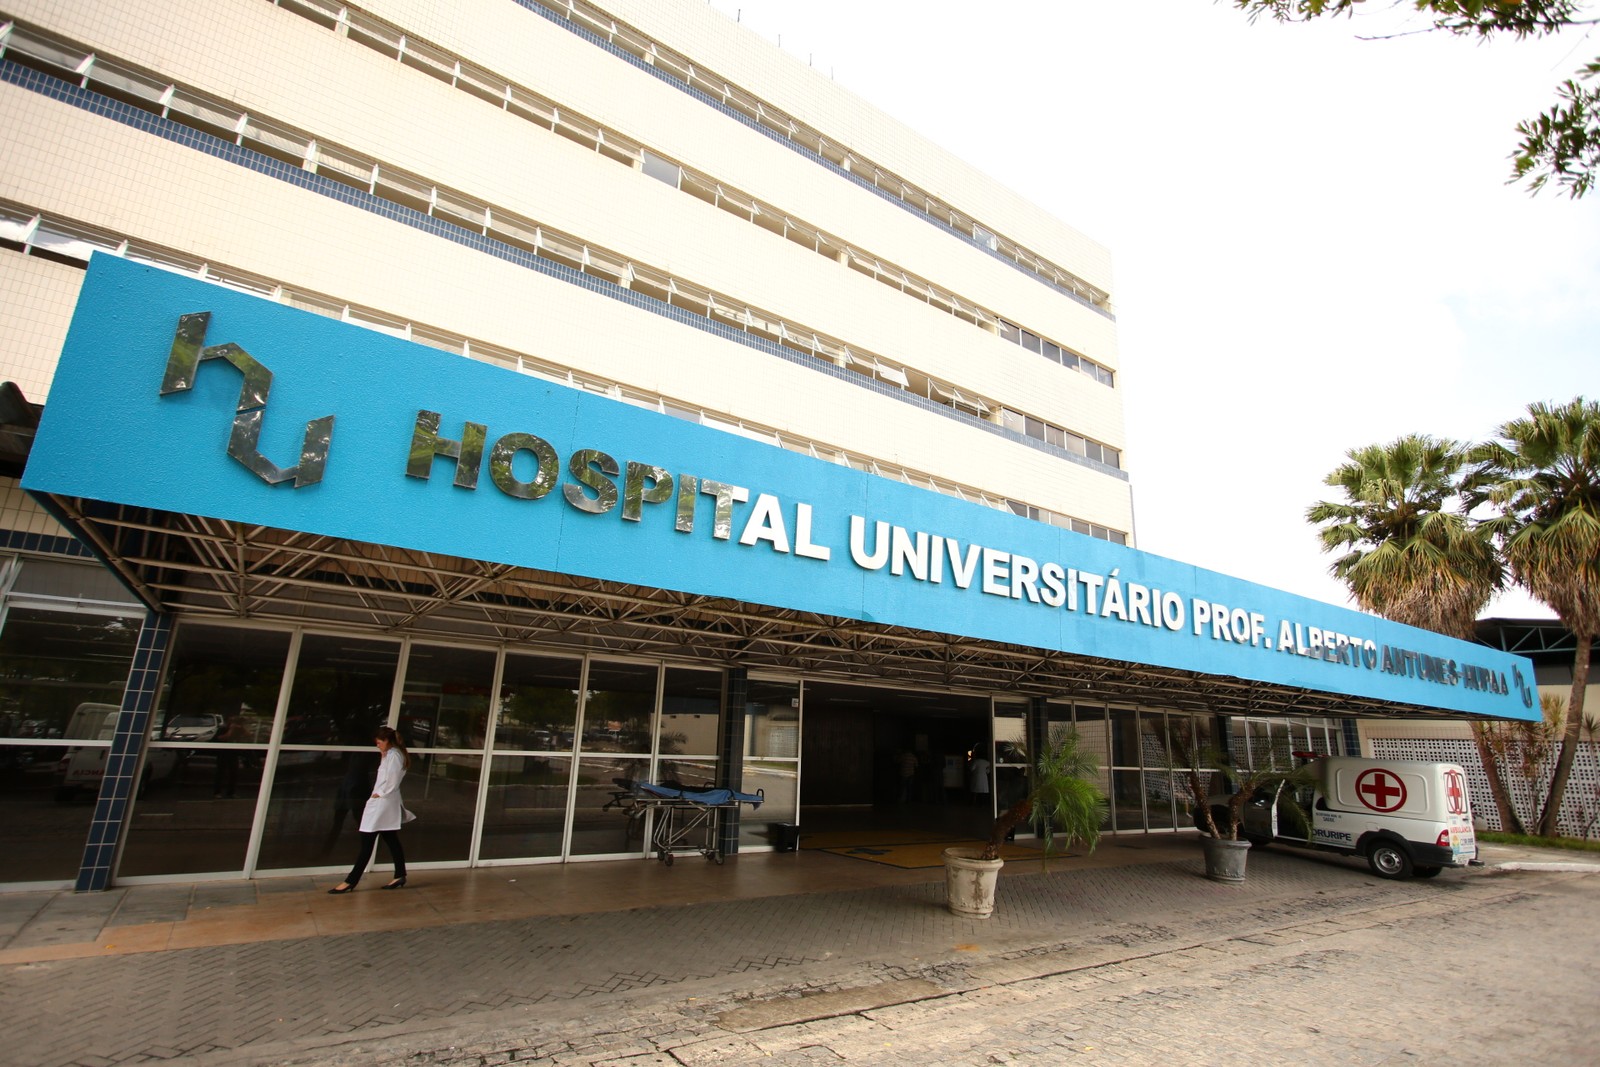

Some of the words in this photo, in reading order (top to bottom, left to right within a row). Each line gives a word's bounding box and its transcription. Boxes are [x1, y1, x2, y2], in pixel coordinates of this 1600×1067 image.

[405, 409, 831, 561] HOSPITAL
[849, 514, 1185, 631] UNIVERSITÁRIO
[1192, 598, 1272, 649] PROF.
[1276, 619, 1377, 670] ALBERTO
